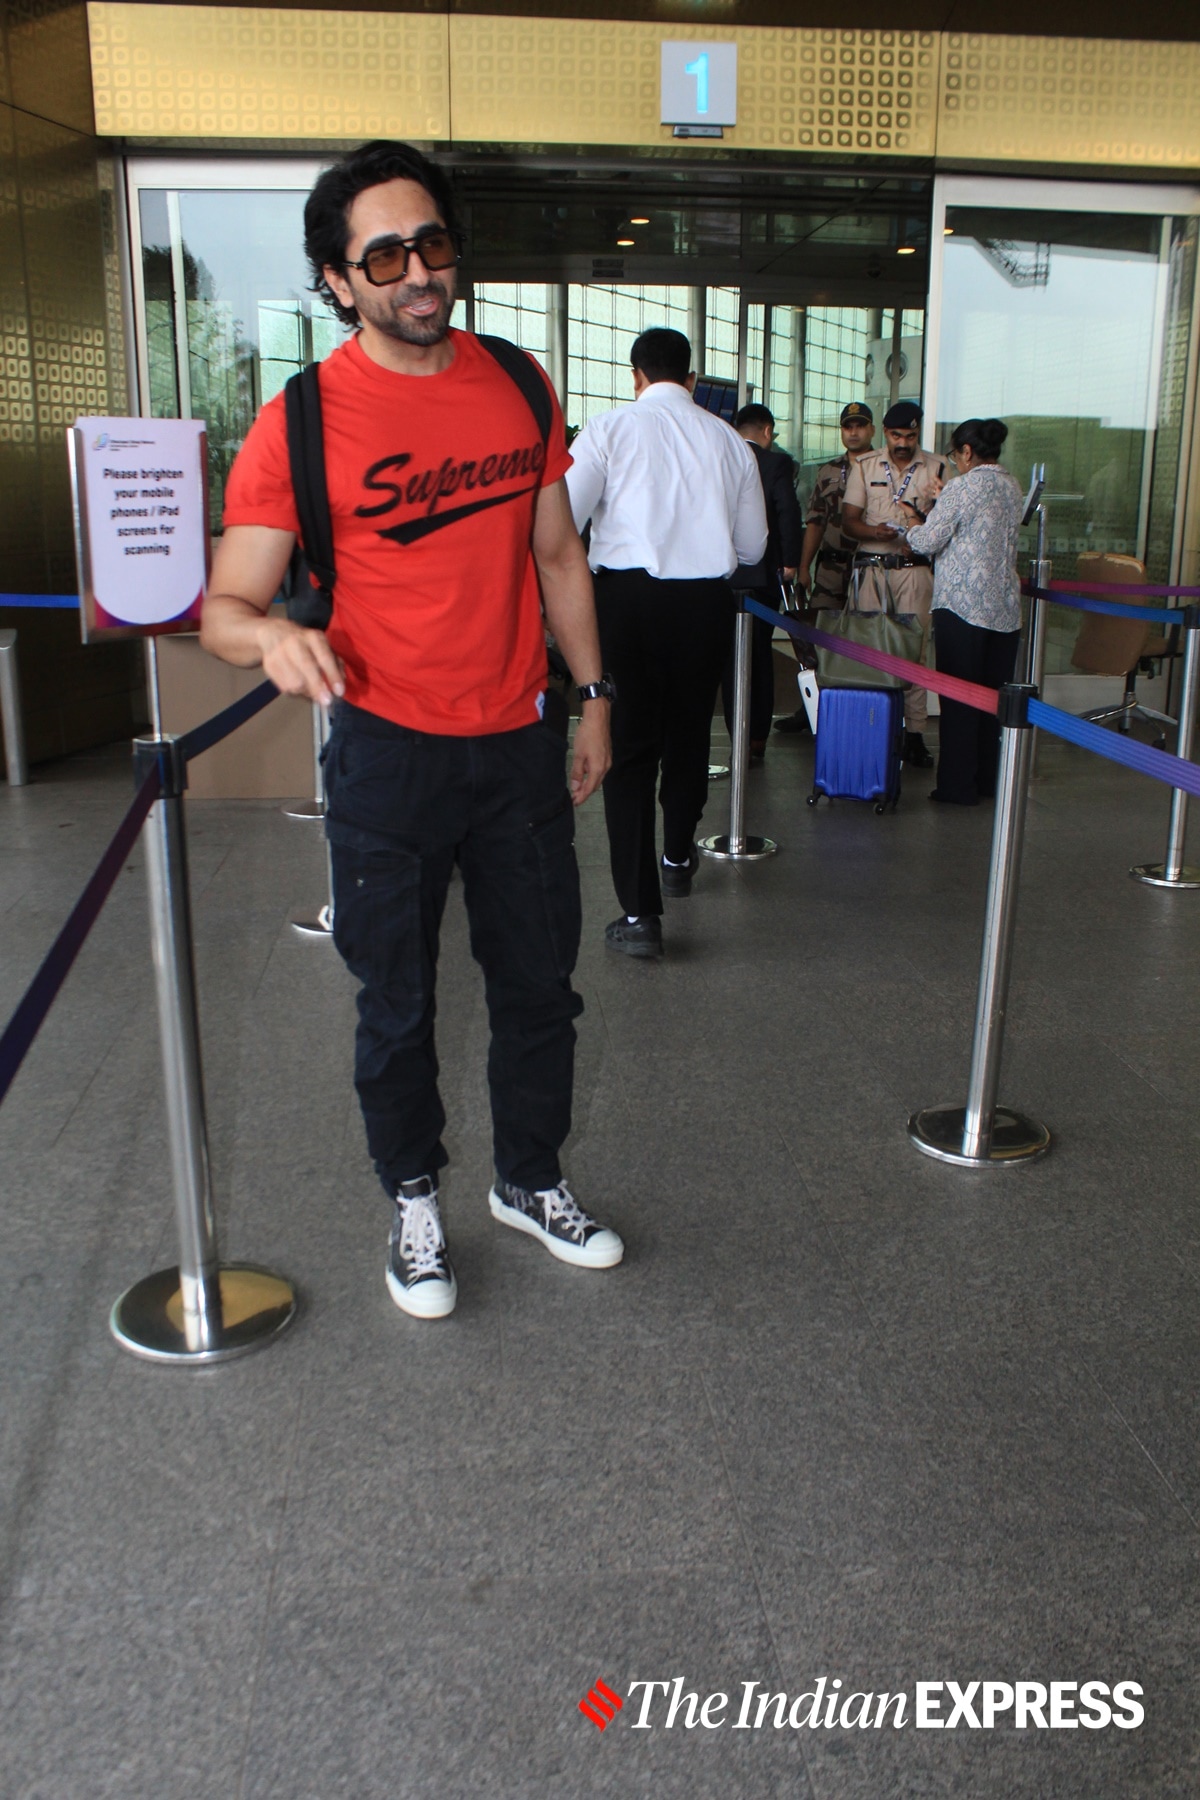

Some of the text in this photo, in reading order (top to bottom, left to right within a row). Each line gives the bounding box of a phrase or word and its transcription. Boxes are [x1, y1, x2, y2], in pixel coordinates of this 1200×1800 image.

[685, 52, 709, 113] 1
[103, 468, 184, 481] Please brighten
[354, 442, 545, 518] Supreme
[115, 487, 175, 500] your mobile
[111, 507, 148, 519] phones
[157, 505, 179, 516] iPad
[117, 524, 175, 537] screens for
[124, 544, 170, 556] scanning
